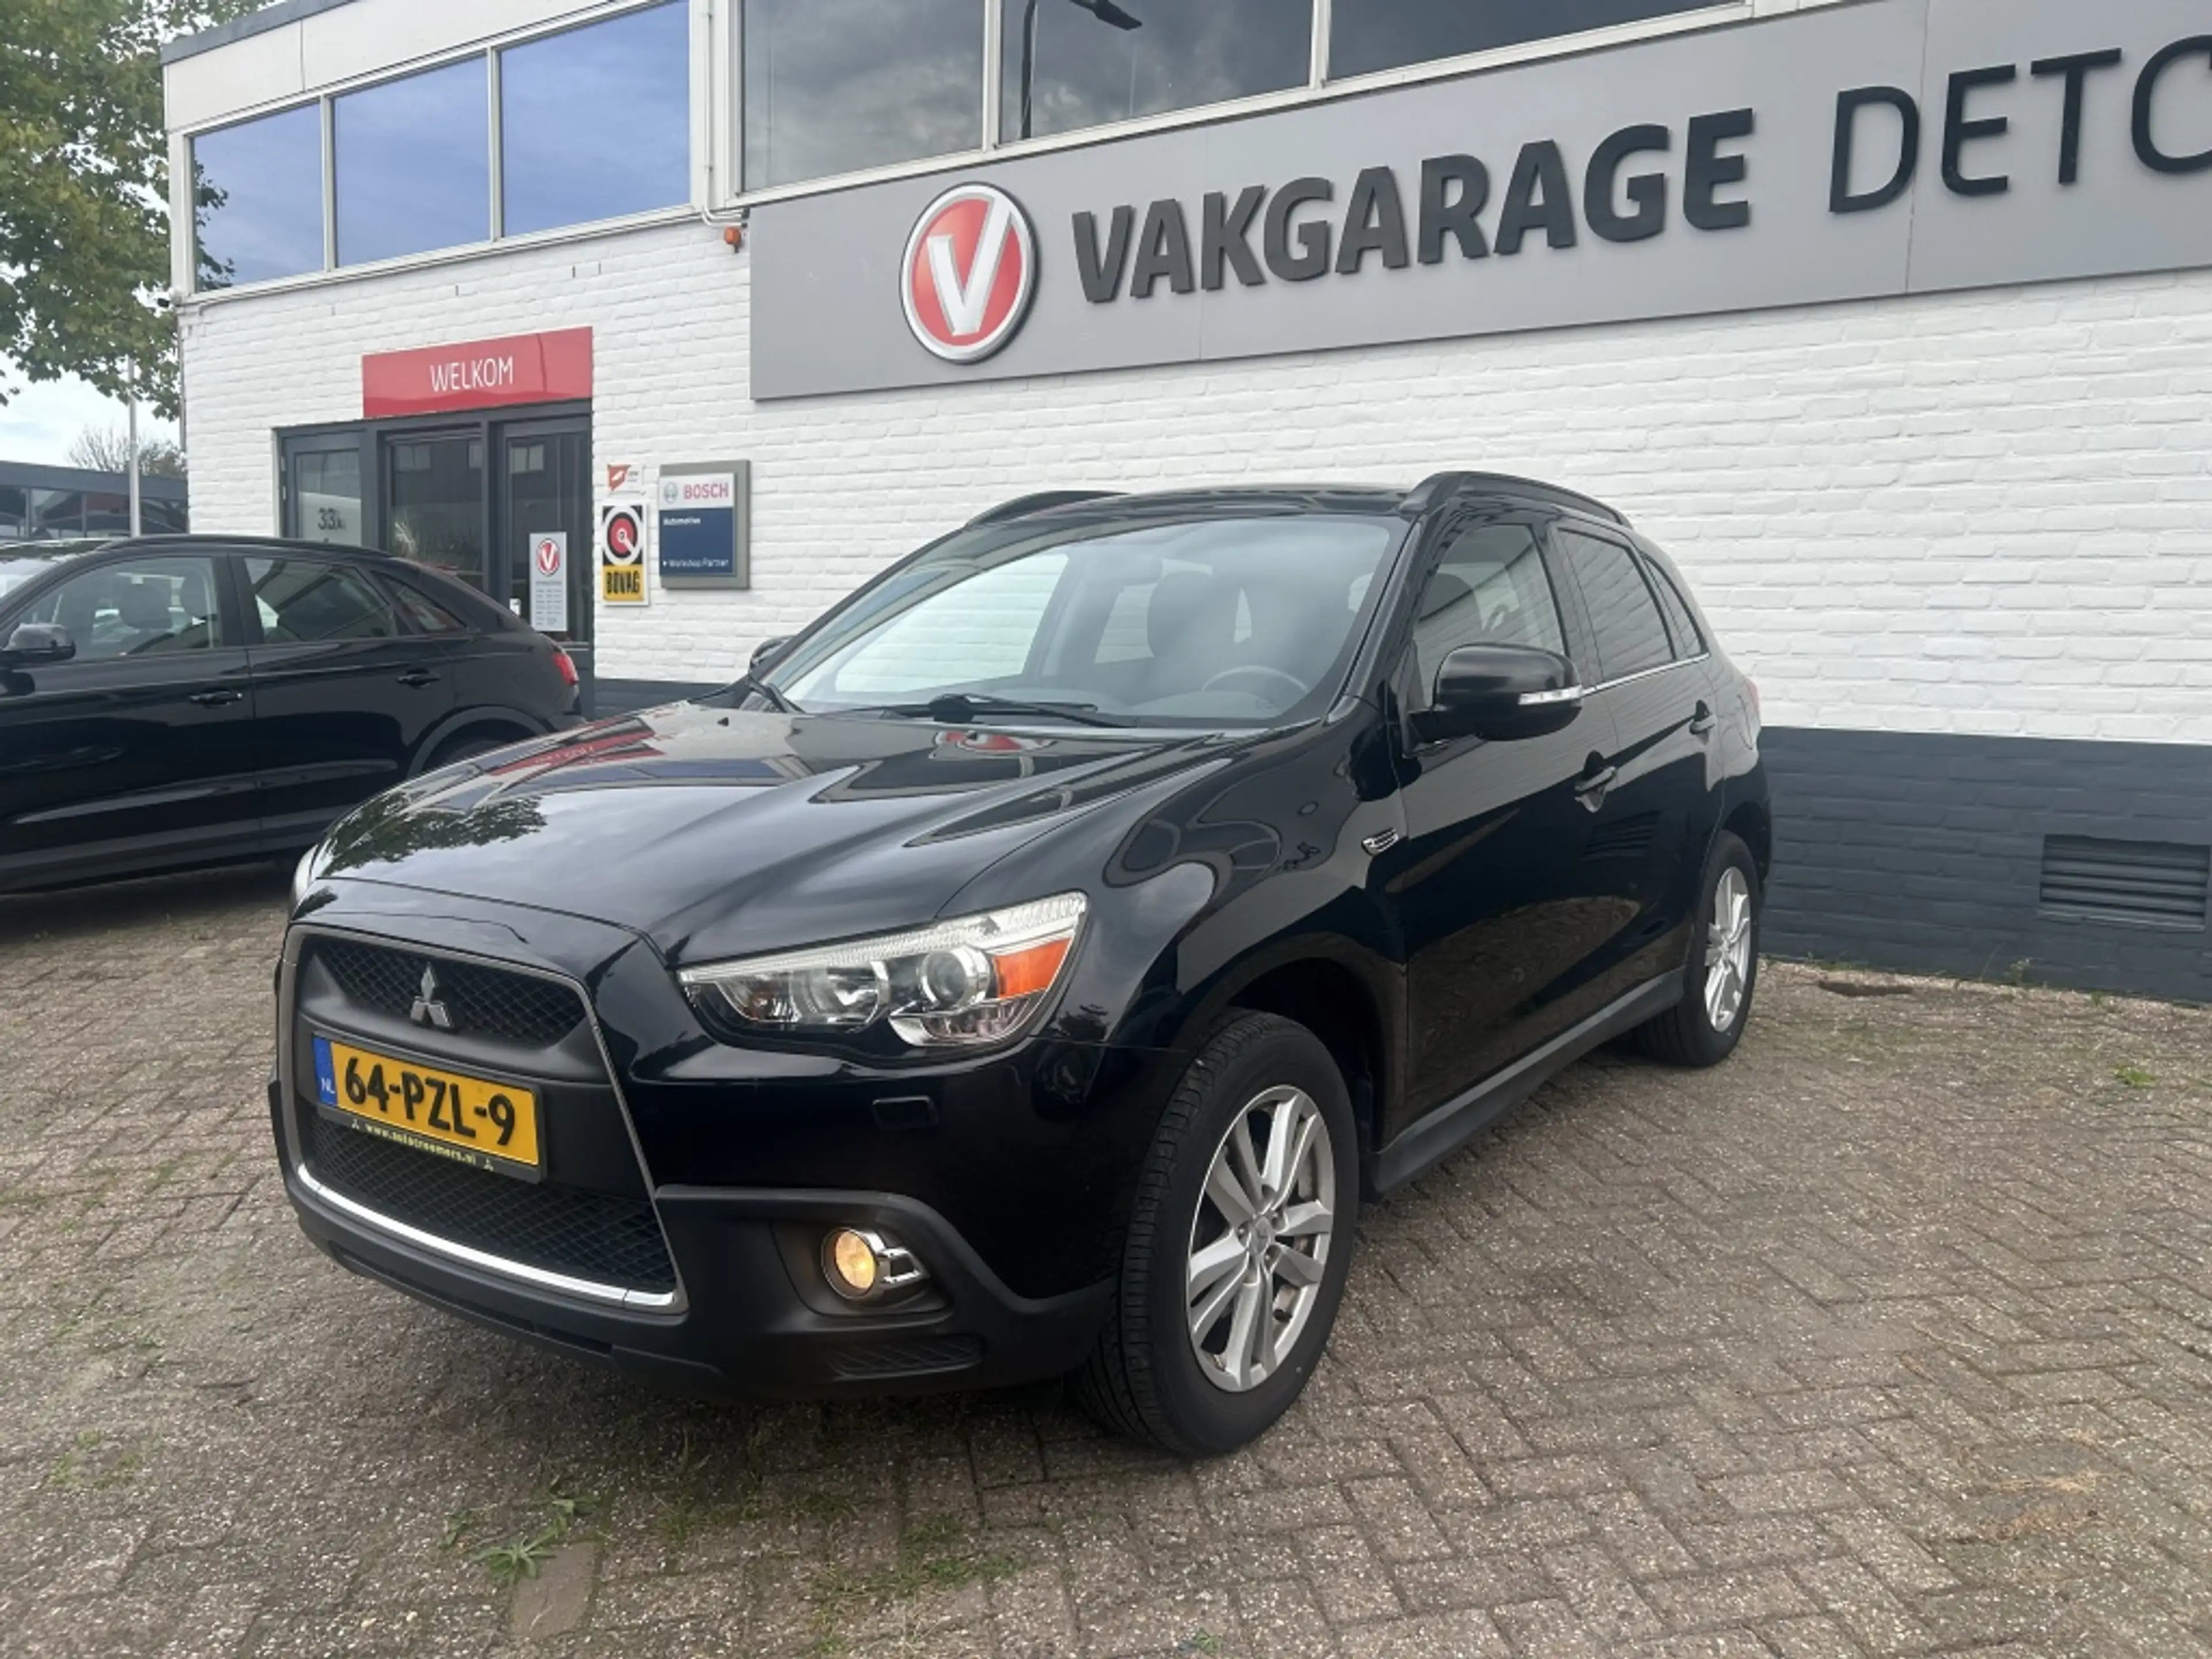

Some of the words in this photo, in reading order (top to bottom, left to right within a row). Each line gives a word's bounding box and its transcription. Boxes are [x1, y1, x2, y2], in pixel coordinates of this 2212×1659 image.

[1071, 108, 1753, 304] VAKGARAGE
[429, 355, 513, 392] WELKOM
[684, 483, 729, 499] BOSCH
[607, 570, 641, 594] BOVAG
[321, 1077, 336, 1094] NL
[346, 1056, 516, 1146] 64-PZL-9
